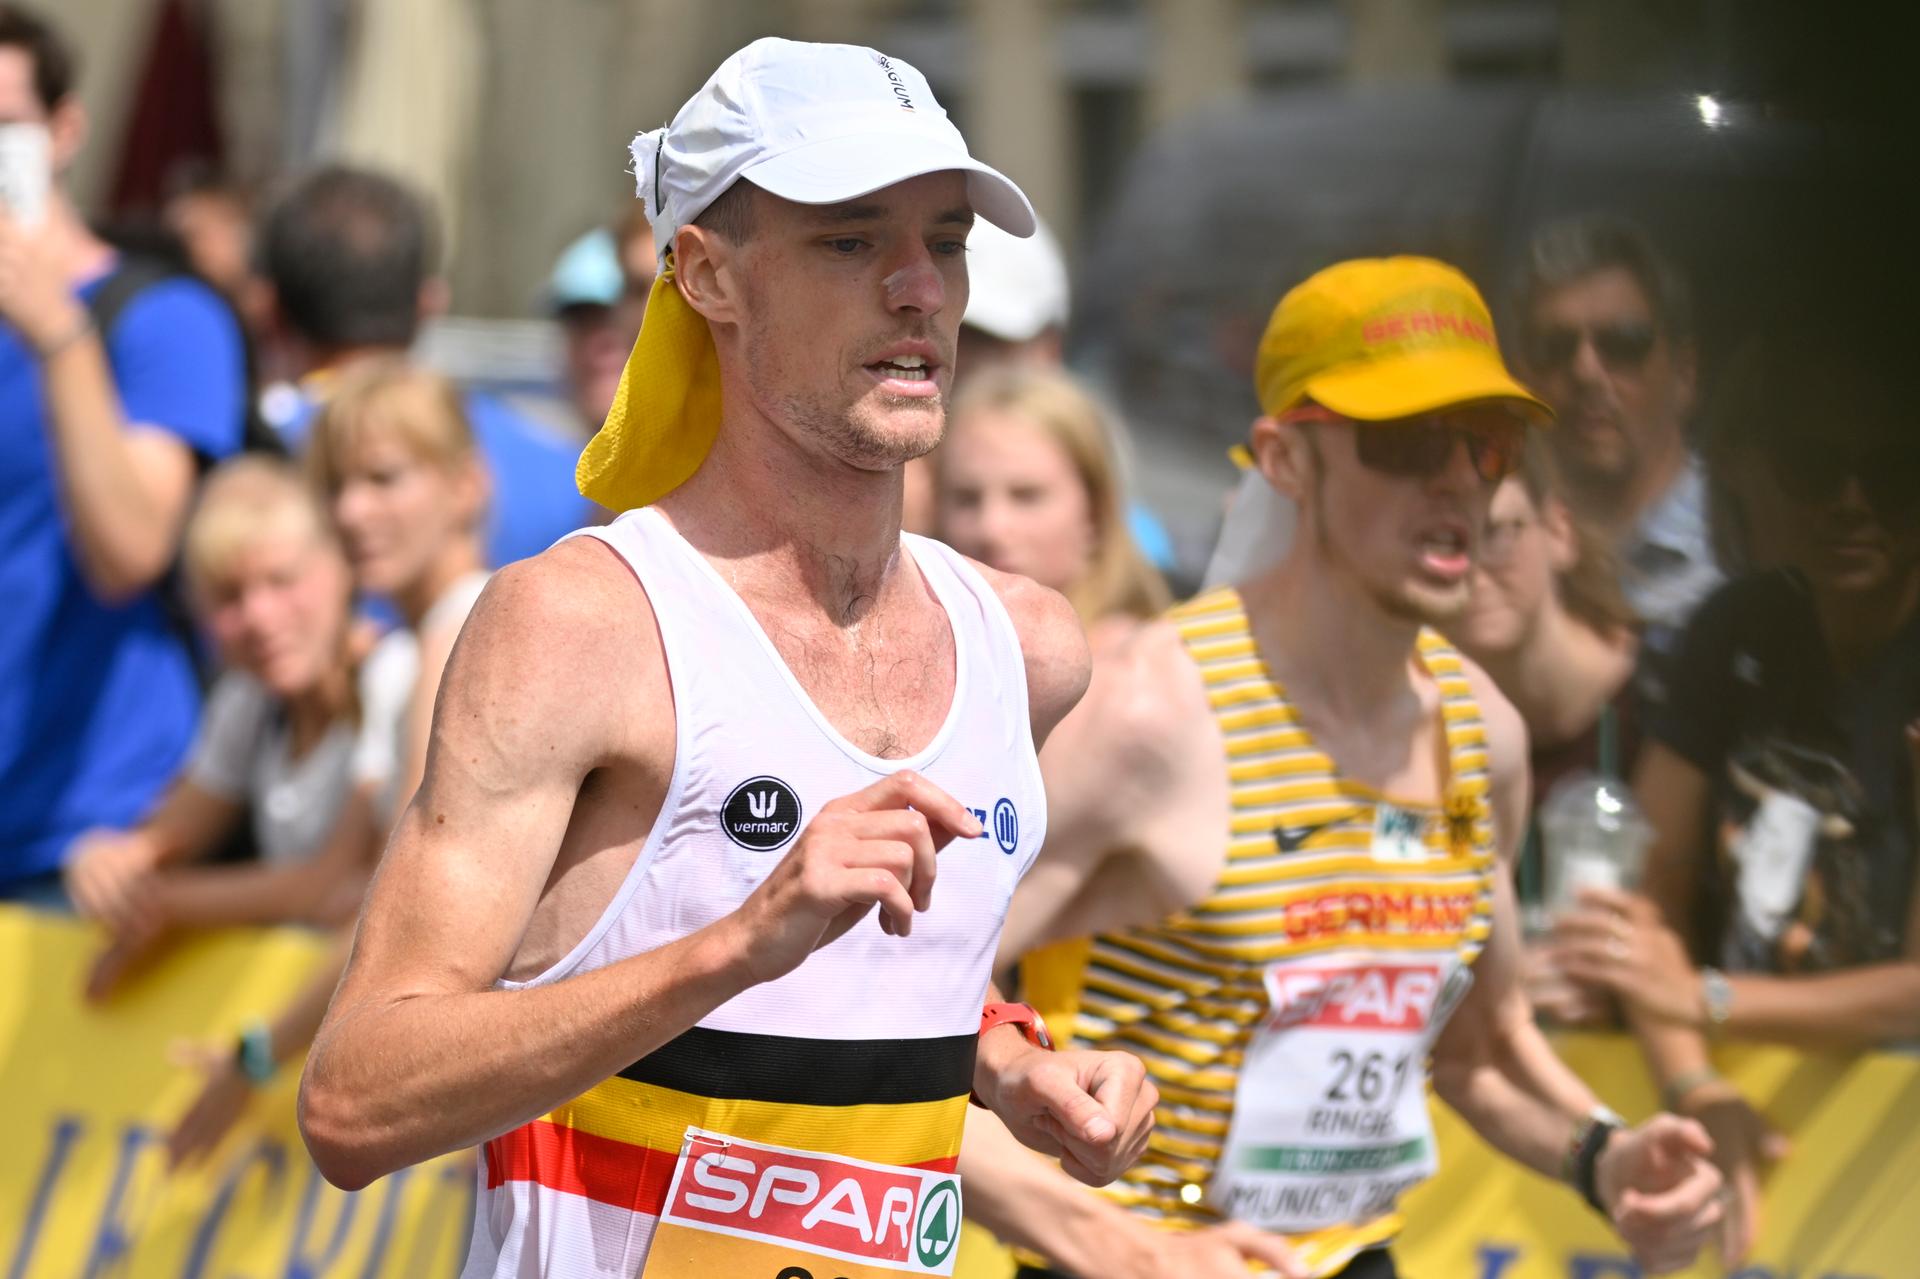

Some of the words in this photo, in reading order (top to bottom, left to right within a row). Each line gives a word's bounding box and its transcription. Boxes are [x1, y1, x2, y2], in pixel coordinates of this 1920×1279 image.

[734, 822, 789, 833] vermarc
[1278, 970, 1437, 1026] SPAR
[1326, 1050, 1411, 1103] 261
[685, 1152, 914, 1248] SPAR
[1229, 1180, 1355, 1221] MUNICH
